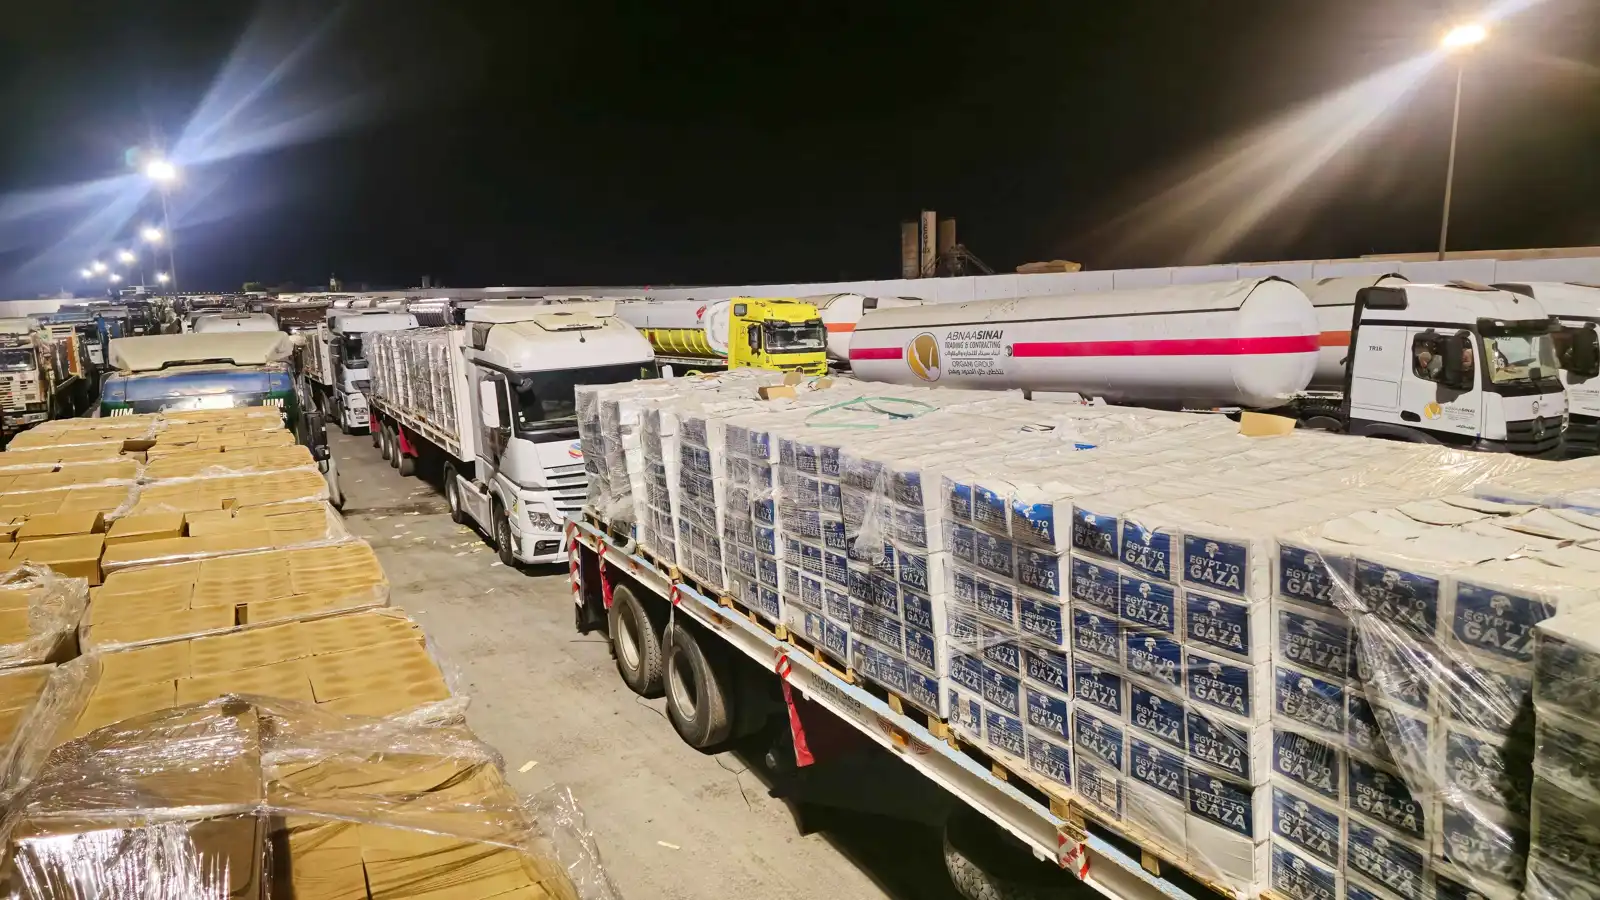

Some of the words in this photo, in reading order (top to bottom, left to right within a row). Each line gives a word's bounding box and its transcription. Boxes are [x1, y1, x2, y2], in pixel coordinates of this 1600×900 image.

[946, 330, 1003, 340] ABNAASINAI
[970, 340, 1000, 348] CONTRACTING
[828, 538, 846, 548] GAZA
[1076, 533, 1112, 554] GAZA
[1100, 532, 1111, 540] TO
[1126, 541, 1151, 555] EGYPT
[1152, 550, 1164, 559] TO
[1126, 550, 1166, 574] GAZA
[1190, 555, 1221, 570] EGYPT
[1226, 563, 1239, 574] TO
[902, 572, 926, 588] GAZA
[1022, 573, 1056, 592] GAZA
[1076, 578, 1102, 590] EGYPT
[1103, 586, 1114, 594] TO
[1191, 564, 1240, 590] GAZA
[1076, 585, 1114, 608] GAZA
[1126, 595, 1153, 608] EGYPT
[1156, 604, 1169, 612] TO
[1408, 598, 1428, 610] TO
[907, 612, 930, 628] GAZA
[1046, 618, 1056, 627] TO
[1126, 604, 1170, 627] GAZA
[1193, 613, 1224, 626] EGYPT
[1227, 623, 1241, 633] TO
[1464, 608, 1514, 631] EGYPT
[1026, 618, 1058, 640] GAZA
[1104, 634, 1115, 643] TO
[1194, 623, 1242, 649] GAZA
[828, 640, 845, 656] GAZA
[1080, 636, 1117, 658] GAZA
[1286, 633, 1321, 651] EGYPT
[1326, 645, 1341, 655] TO
[910, 648, 933, 664] GAZA
[988, 649, 1016, 668] GAZA
[1132, 648, 1159, 662] EGYPT
[1161, 658, 1175, 668] TO
[1286, 642, 1342, 672] GAZA
[952, 670, 978, 690] GAZA
[1031, 666, 1064, 688] GAZA
[1053, 666, 1062, 675] TO
[1132, 658, 1176, 682] GAZA
[812, 672, 839, 694] Royal
[842, 691, 861, 709] Sea
[882, 672, 904, 690] GAZA
[1080, 677, 1104, 691] EGYPT
[1106, 688, 1116, 696] TO
[1194, 675, 1226, 690] EGYPT
[1228, 686, 1242, 695] TO
[914, 691, 936, 709] GAZA
[986, 690, 1016, 711] GAZA
[1080, 684, 1118, 710] GAZA
[1195, 685, 1244, 714] GAZA
[1030, 706, 1050, 718] EGYPT
[1052, 713, 1062, 722] TO
[1136, 704, 1164, 719] EGYPT
[1166, 719, 1179, 729] TO
[1031, 715, 1064, 736] GAZA
[1137, 712, 1180, 743] GAZA
[992, 733, 1021, 752] GAZA
[1080, 727, 1104, 743] EGYPT
[1107, 740, 1118, 750] TO
[1194, 733, 1225, 750] EGYPT
[1228, 746, 1240, 756] TO
[1080, 735, 1118, 764] GAZA
[1194, 743, 1242, 772] GAZA
[1034, 761, 1066, 784] GAZA
[1136, 756, 1163, 771] EGYPT
[1166, 770, 1178, 780] TO
[1279, 758, 1333, 793] GAZA
[1137, 764, 1180, 794] GAZA
[1196, 788, 1226, 805] EGYPT
[1230, 803, 1244, 814] TO
[1398, 800, 1415, 814] TO
[1196, 800, 1246, 830] GAZA
[1356, 793, 1417, 831] GAZA
[1279, 820, 1332, 857] GAZA
[1316, 828, 1331, 840] TO
[1355, 855, 1416, 898] GAZA
